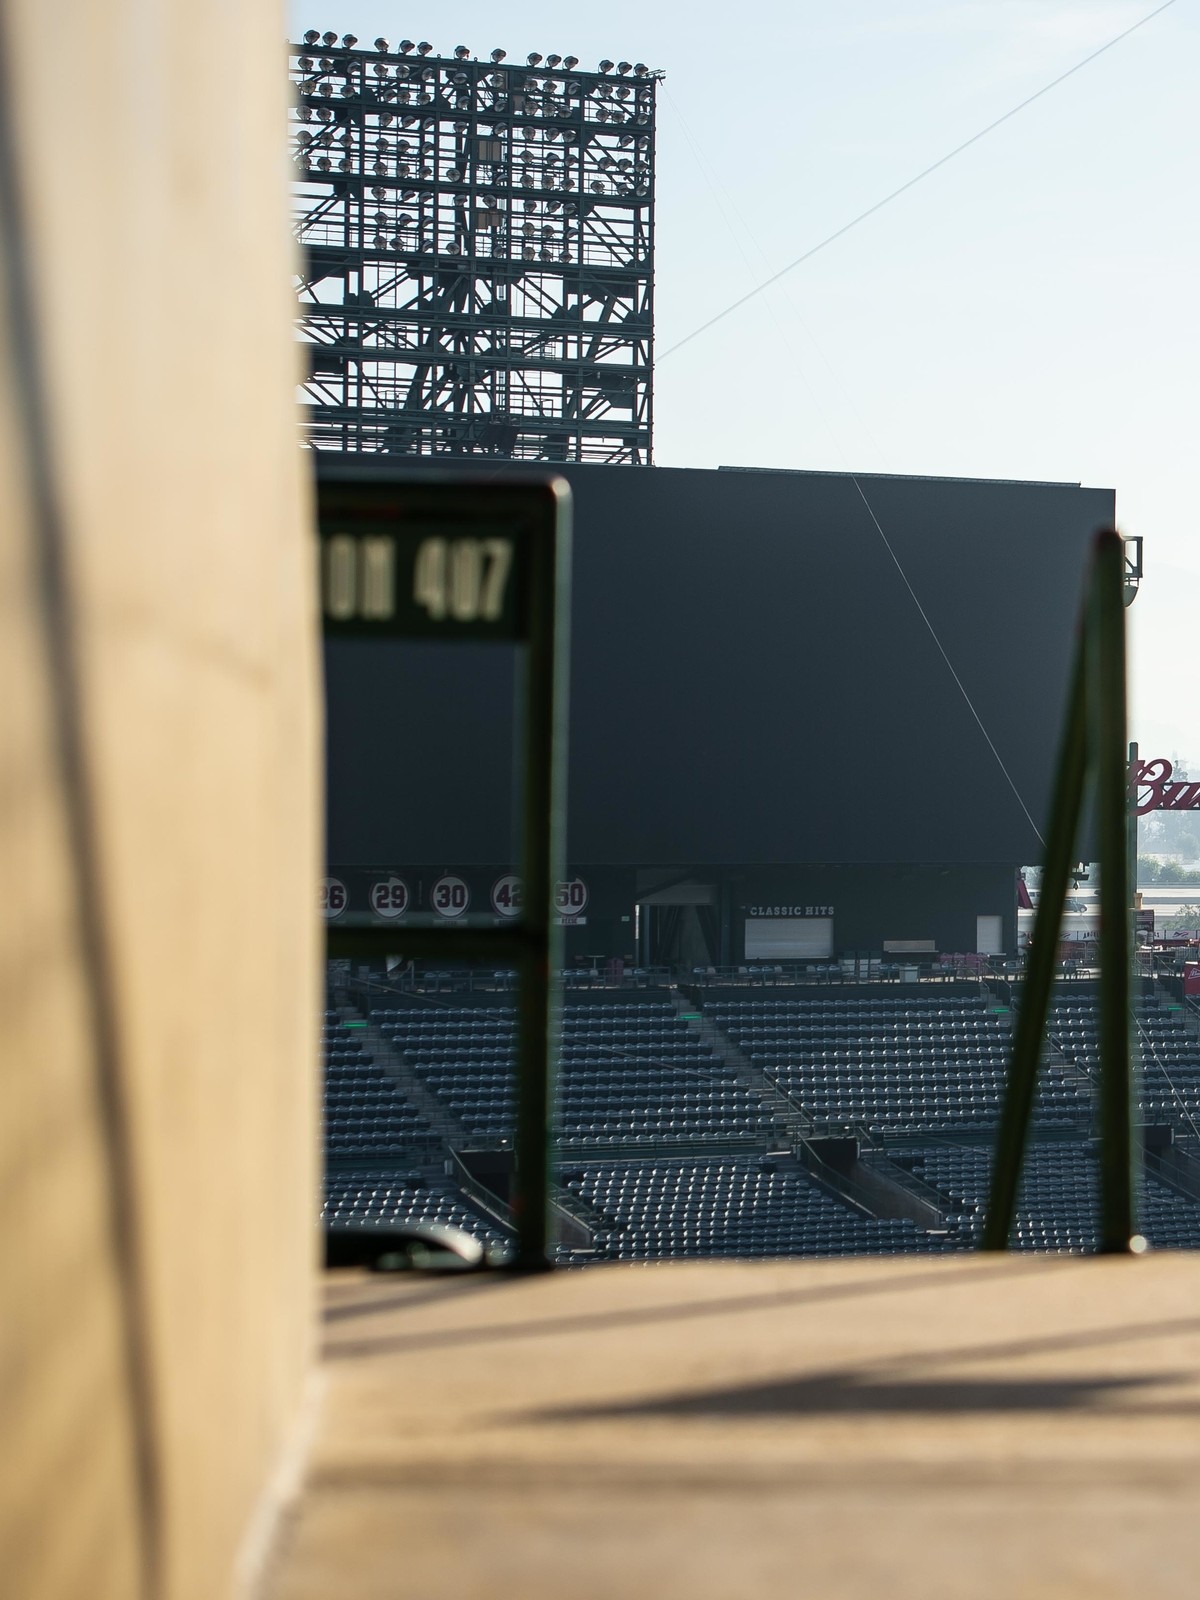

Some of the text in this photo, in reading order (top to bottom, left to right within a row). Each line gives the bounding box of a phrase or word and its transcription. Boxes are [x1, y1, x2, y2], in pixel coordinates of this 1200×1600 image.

[414, 536, 513, 620] 407
[376, 885, 405, 908] 29
[436, 884, 466, 908] 30
[556, 883, 585, 907] 50
[750, 906, 835, 916] CLASSIC HITS
